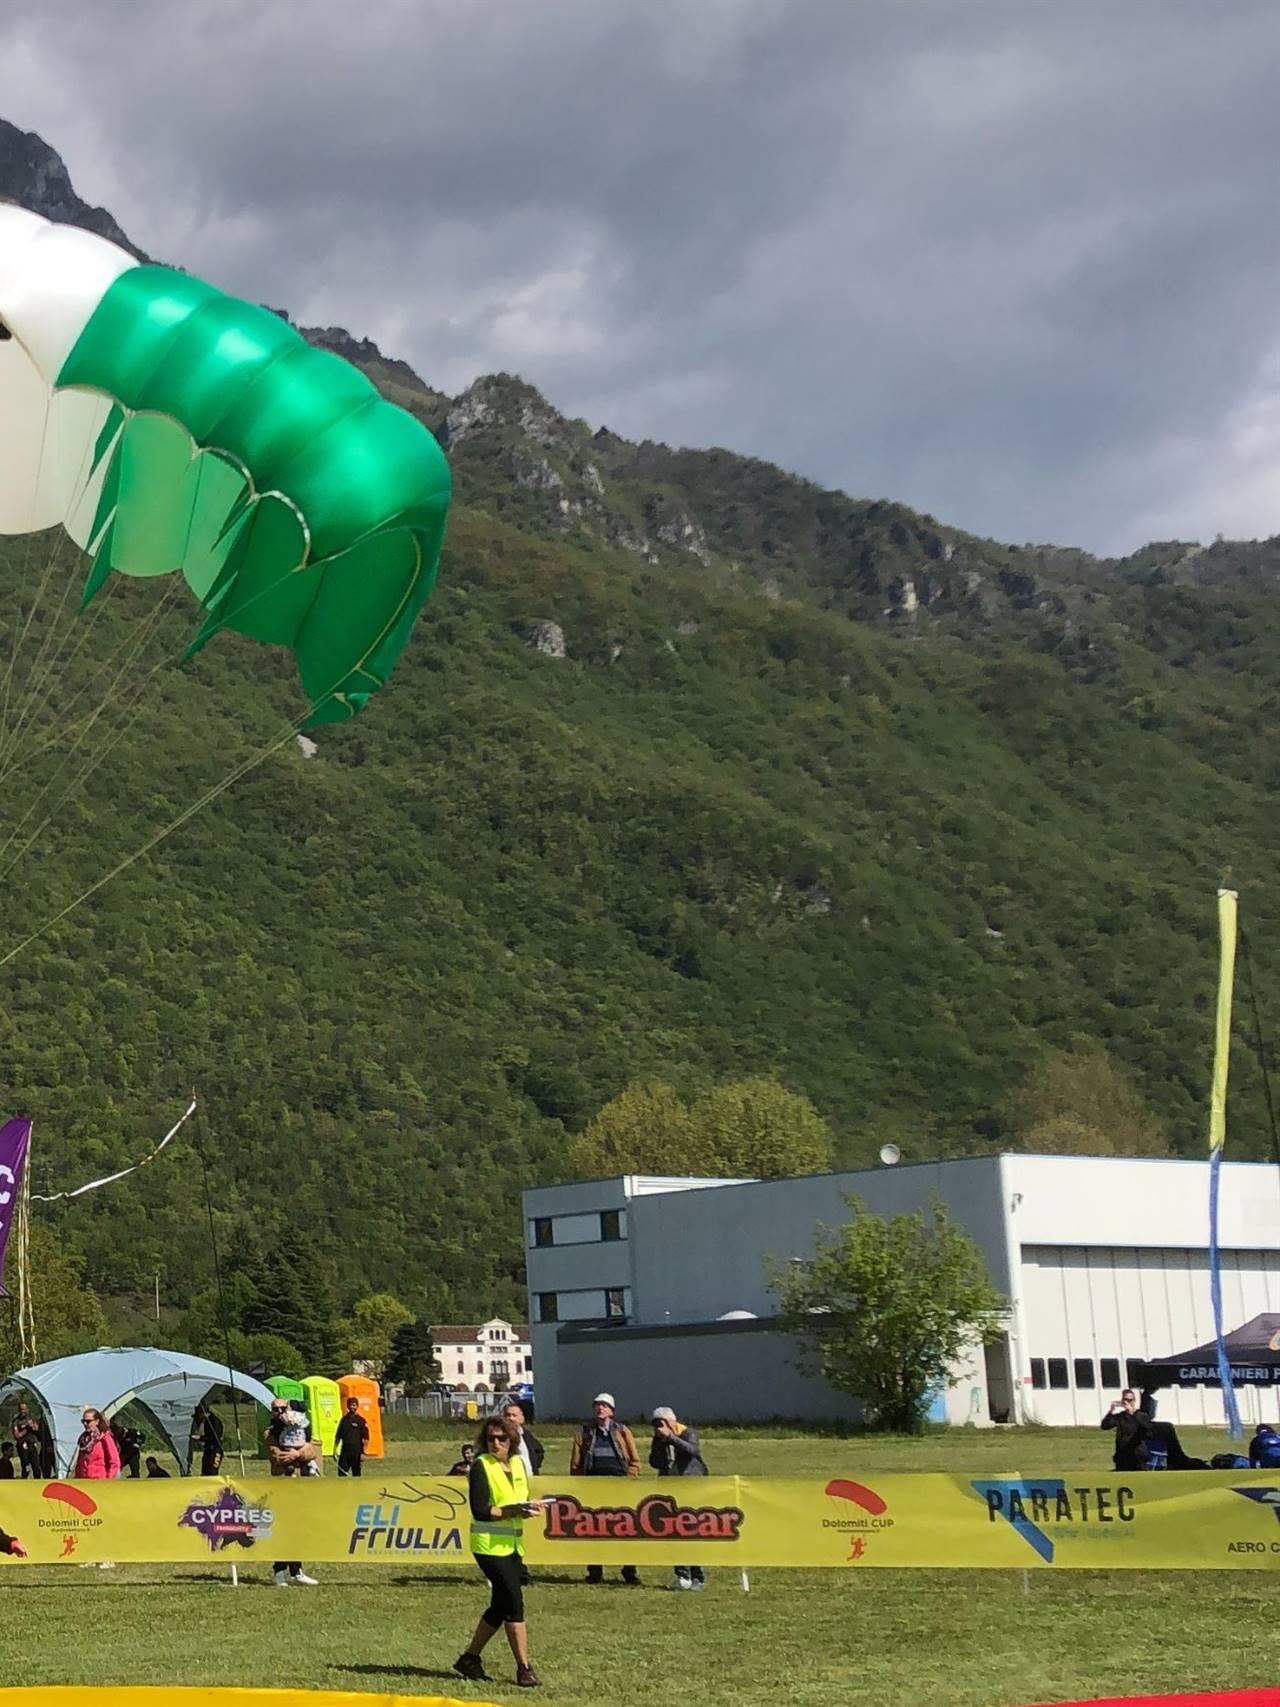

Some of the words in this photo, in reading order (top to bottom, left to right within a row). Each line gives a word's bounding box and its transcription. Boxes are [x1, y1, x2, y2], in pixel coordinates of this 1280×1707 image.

[1180, 1367, 1269, 1379] CARANIERI
[986, 1487, 1135, 1522] PARATEC
[191, 1509, 273, 1524] CYPRES
[355, 1504, 400, 1526] ELI
[38, 1518, 80, 1528] Dolomiti
[82, 1518, 103, 1528] CUP
[822, 1519, 868, 1528] Dolomiti
[871, 1519, 894, 1528] CUP
[348, 1528, 462, 1554] FRIULIA
[1227, 1542, 1266, 1553] AERO
